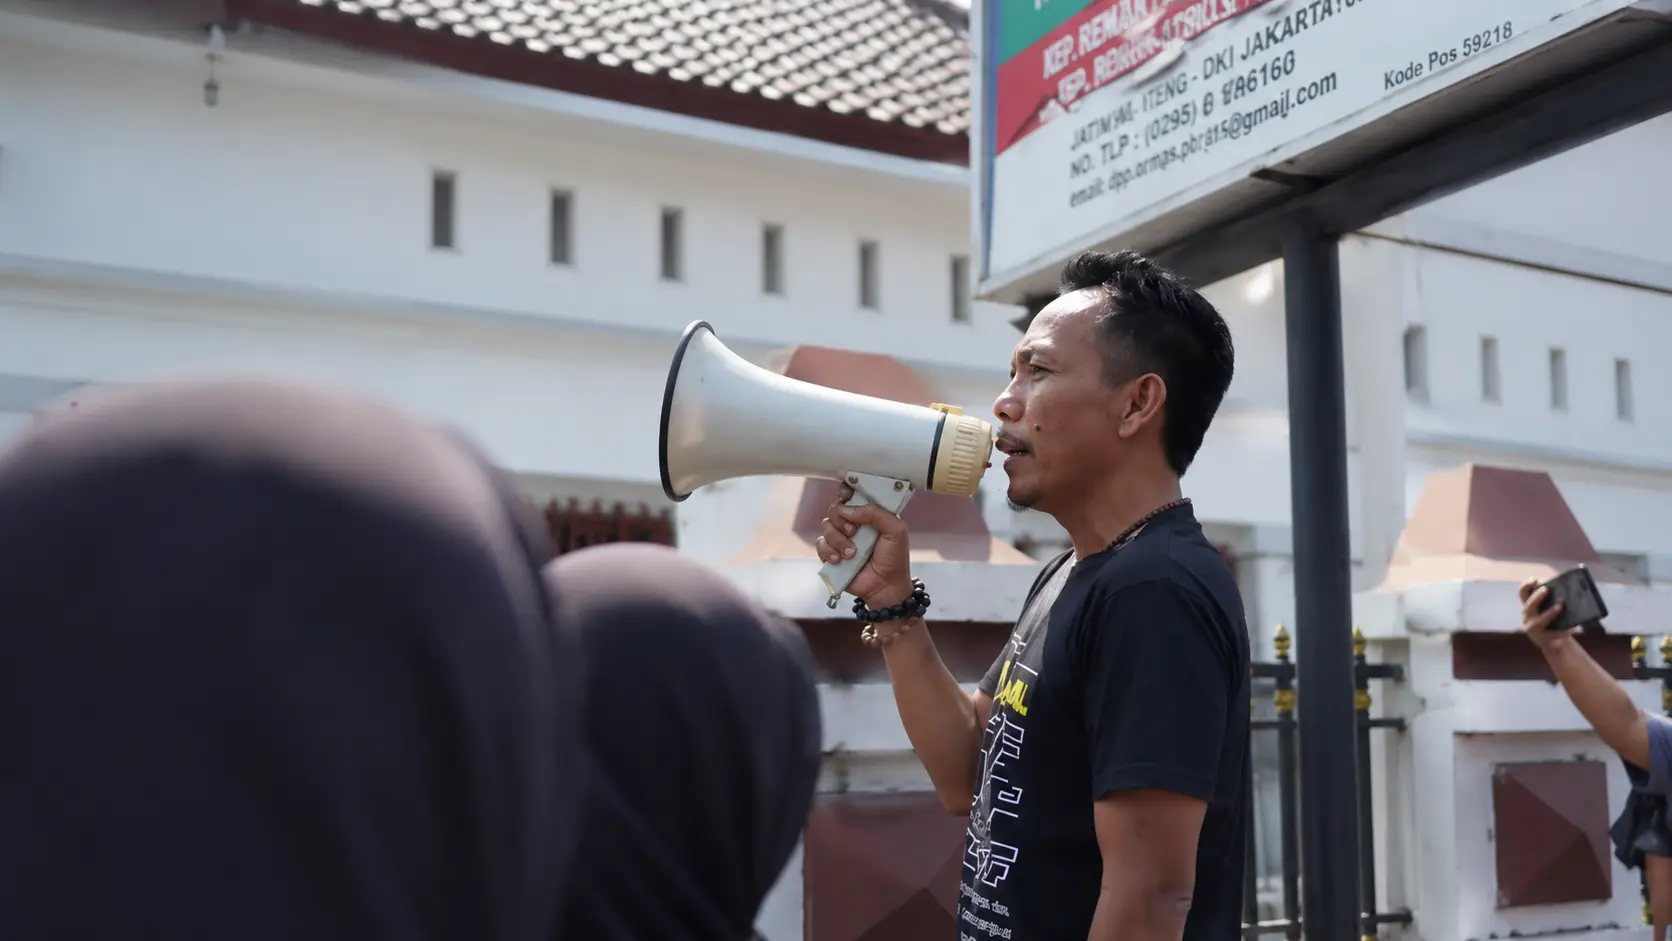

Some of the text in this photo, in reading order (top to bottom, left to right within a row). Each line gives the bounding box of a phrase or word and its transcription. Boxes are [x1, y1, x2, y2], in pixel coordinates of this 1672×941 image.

[1203, 45, 1234, 80] DKI
[1384, 21, 1513, 90] Kode Pos 59218
[1070, 153, 1096, 179] NO.
[1101, 133, 1129, 165] TLP
[1144, 99, 1197, 148] (0295)
